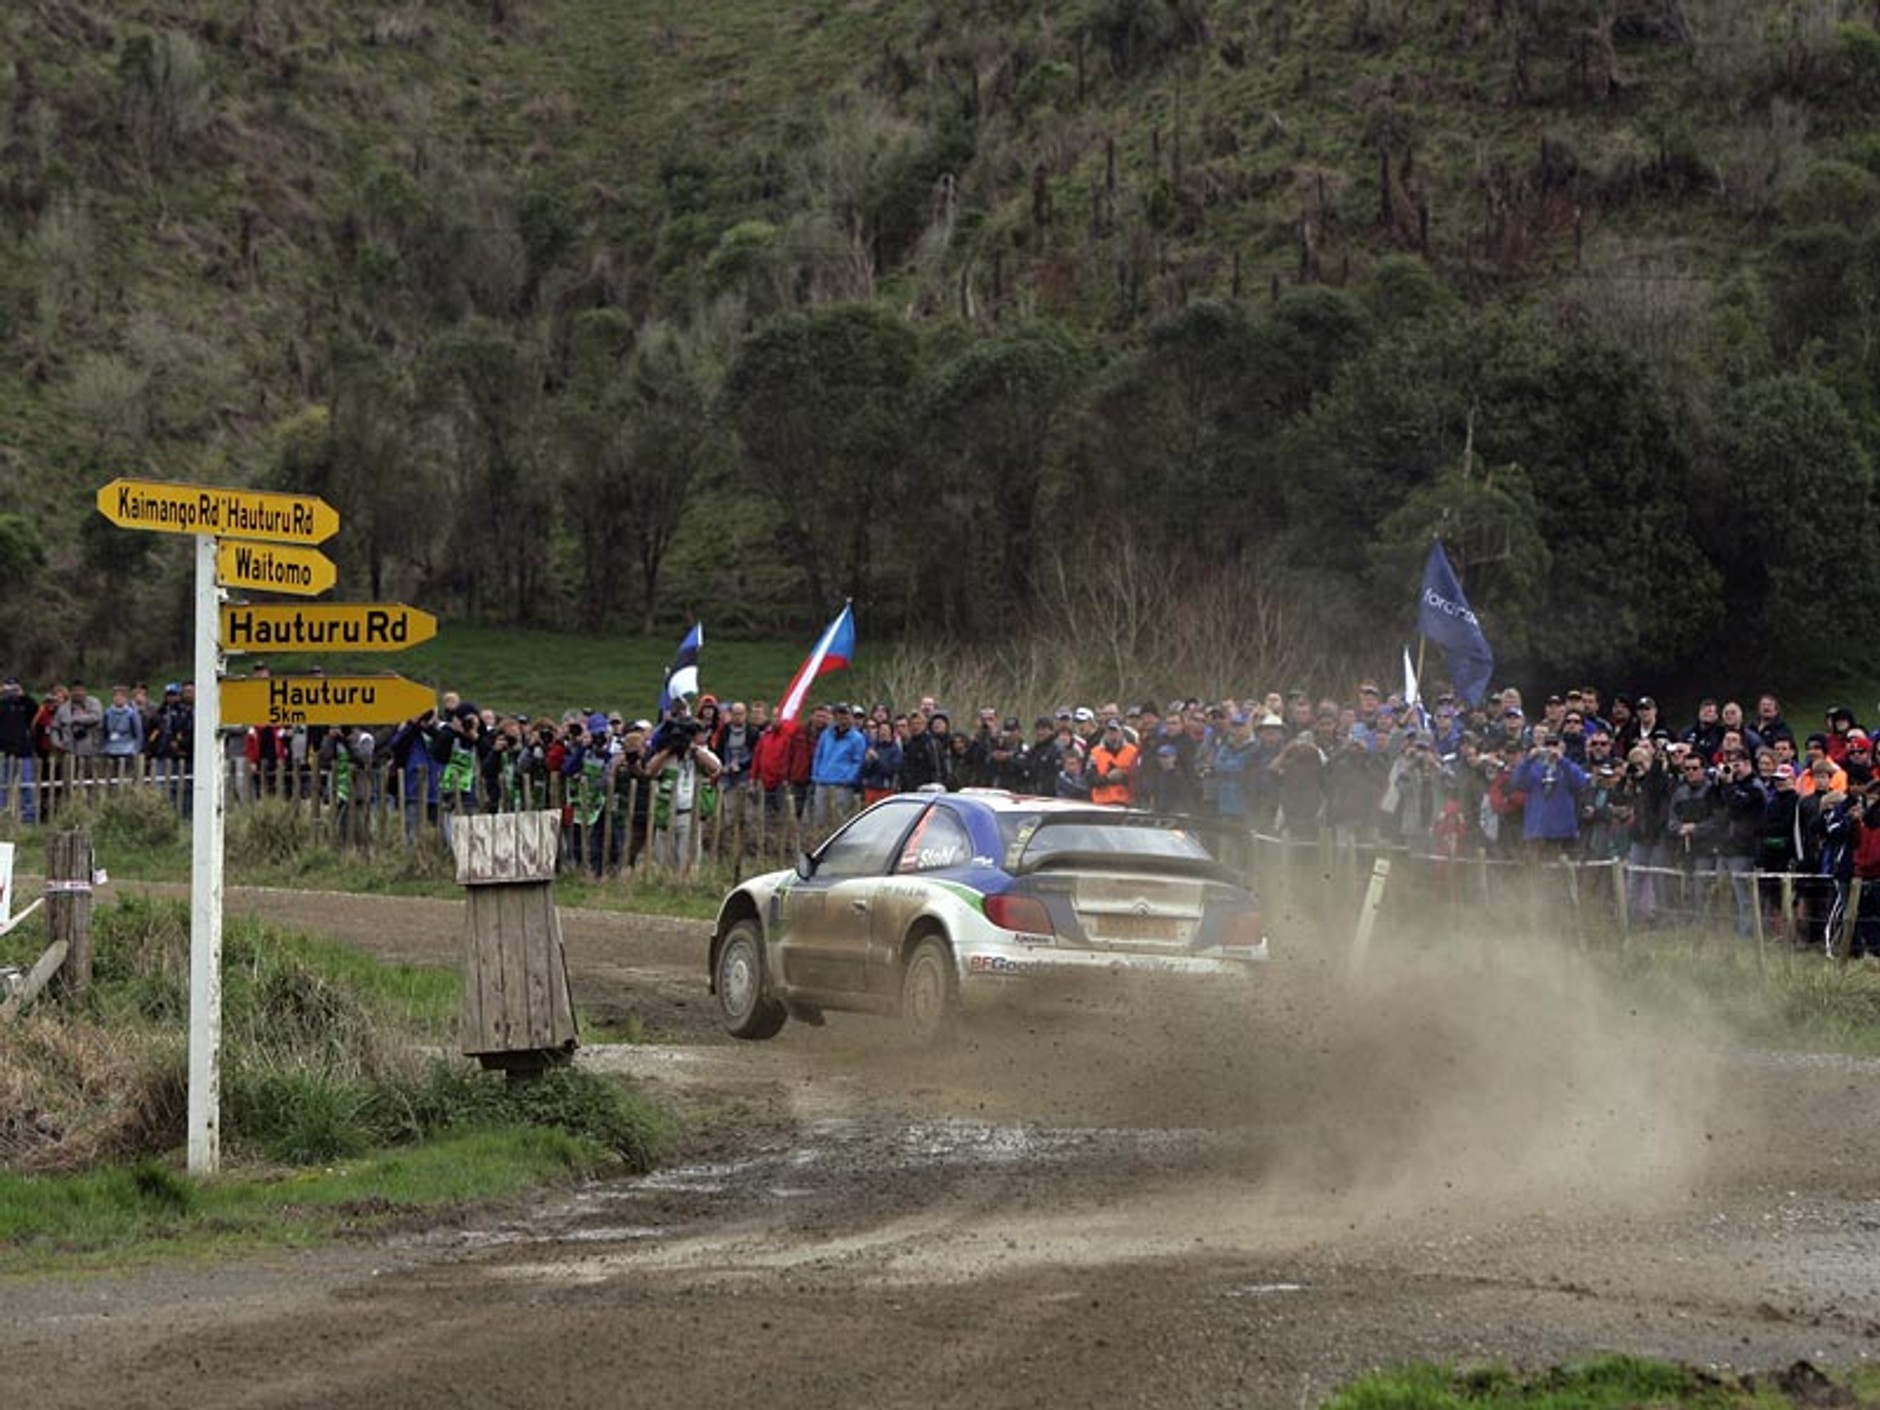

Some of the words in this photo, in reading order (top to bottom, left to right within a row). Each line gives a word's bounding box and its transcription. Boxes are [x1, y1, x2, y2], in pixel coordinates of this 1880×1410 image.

[117, 486, 197, 530] Kaimango
[199, 493, 220, 526] Rd
[227, 497, 291, 534] Hauturu
[293, 503, 315, 536] Rd
[236, 547, 312, 586] Waitomo
[229, 611, 360, 644] Hauturu
[366, 610, 408, 643] Rd
[269, 679, 376, 706] Hauturu
[268, 706, 307, 724] 5km
